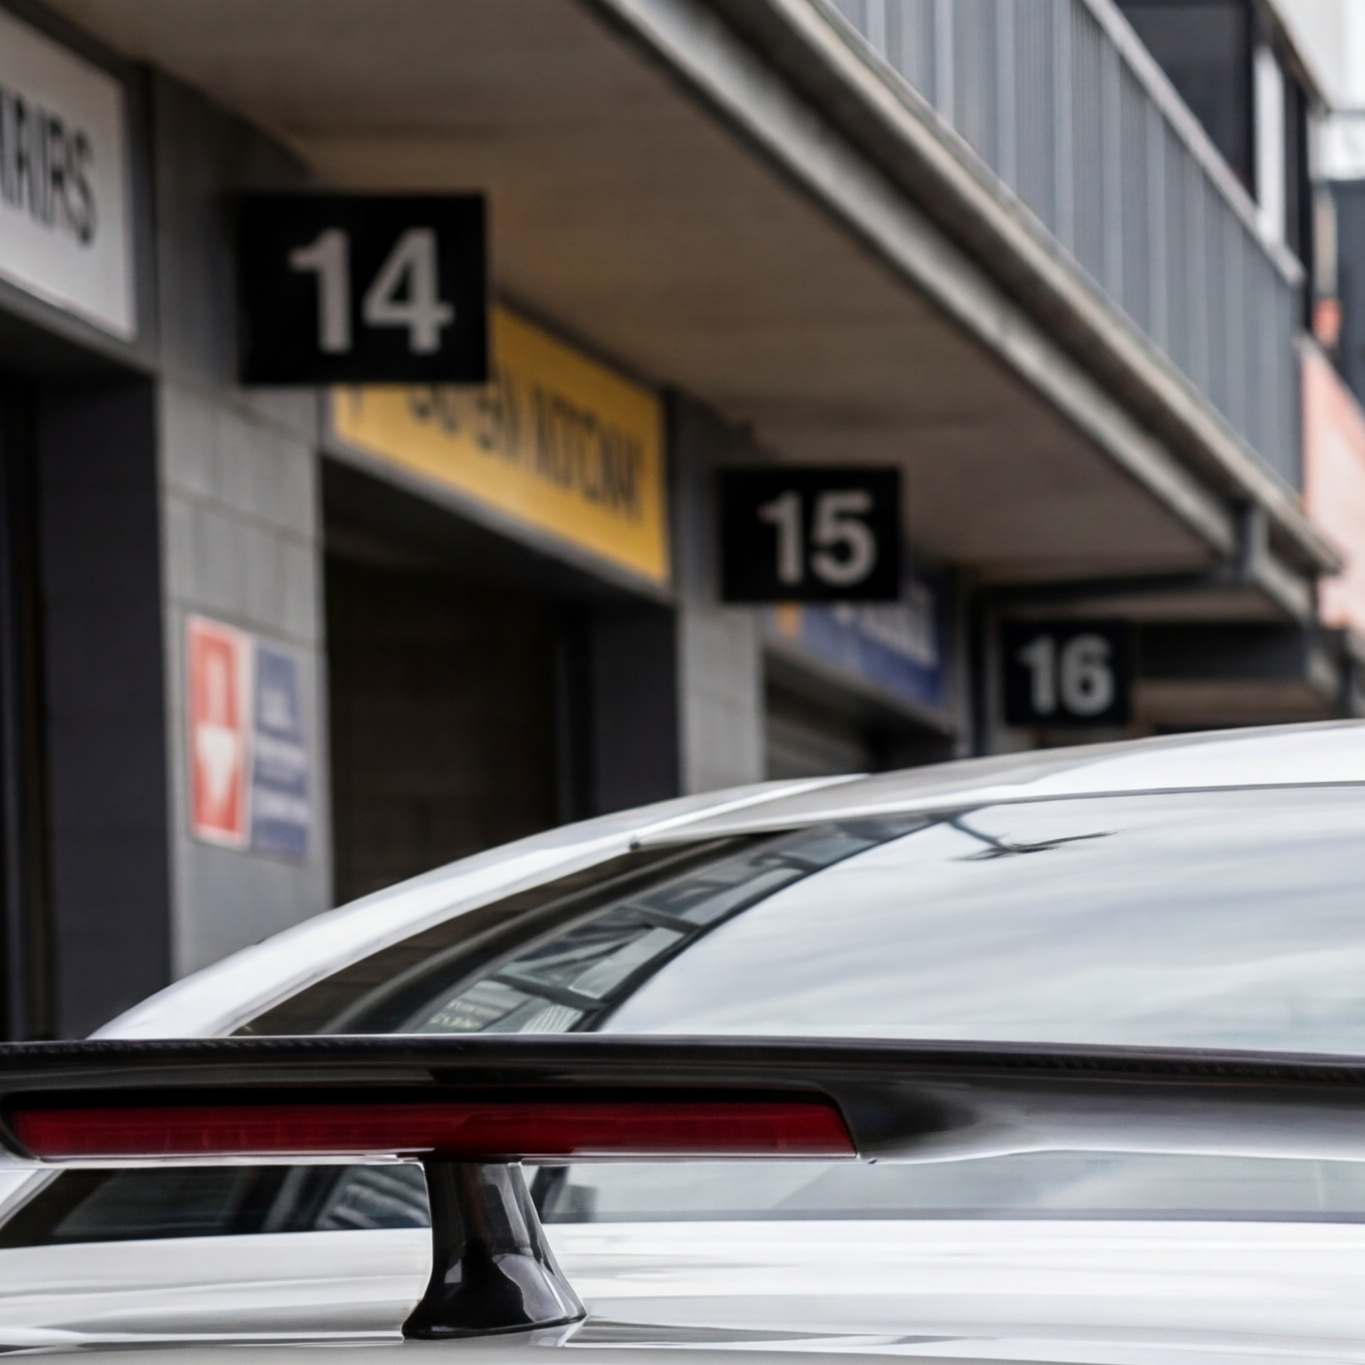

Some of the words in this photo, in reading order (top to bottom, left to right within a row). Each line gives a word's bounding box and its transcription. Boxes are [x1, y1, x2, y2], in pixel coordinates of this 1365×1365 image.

[289, 228, 454, 354] 14
[757, 489, 876, 585] 15
[1018, 633, 1114, 716] 16
